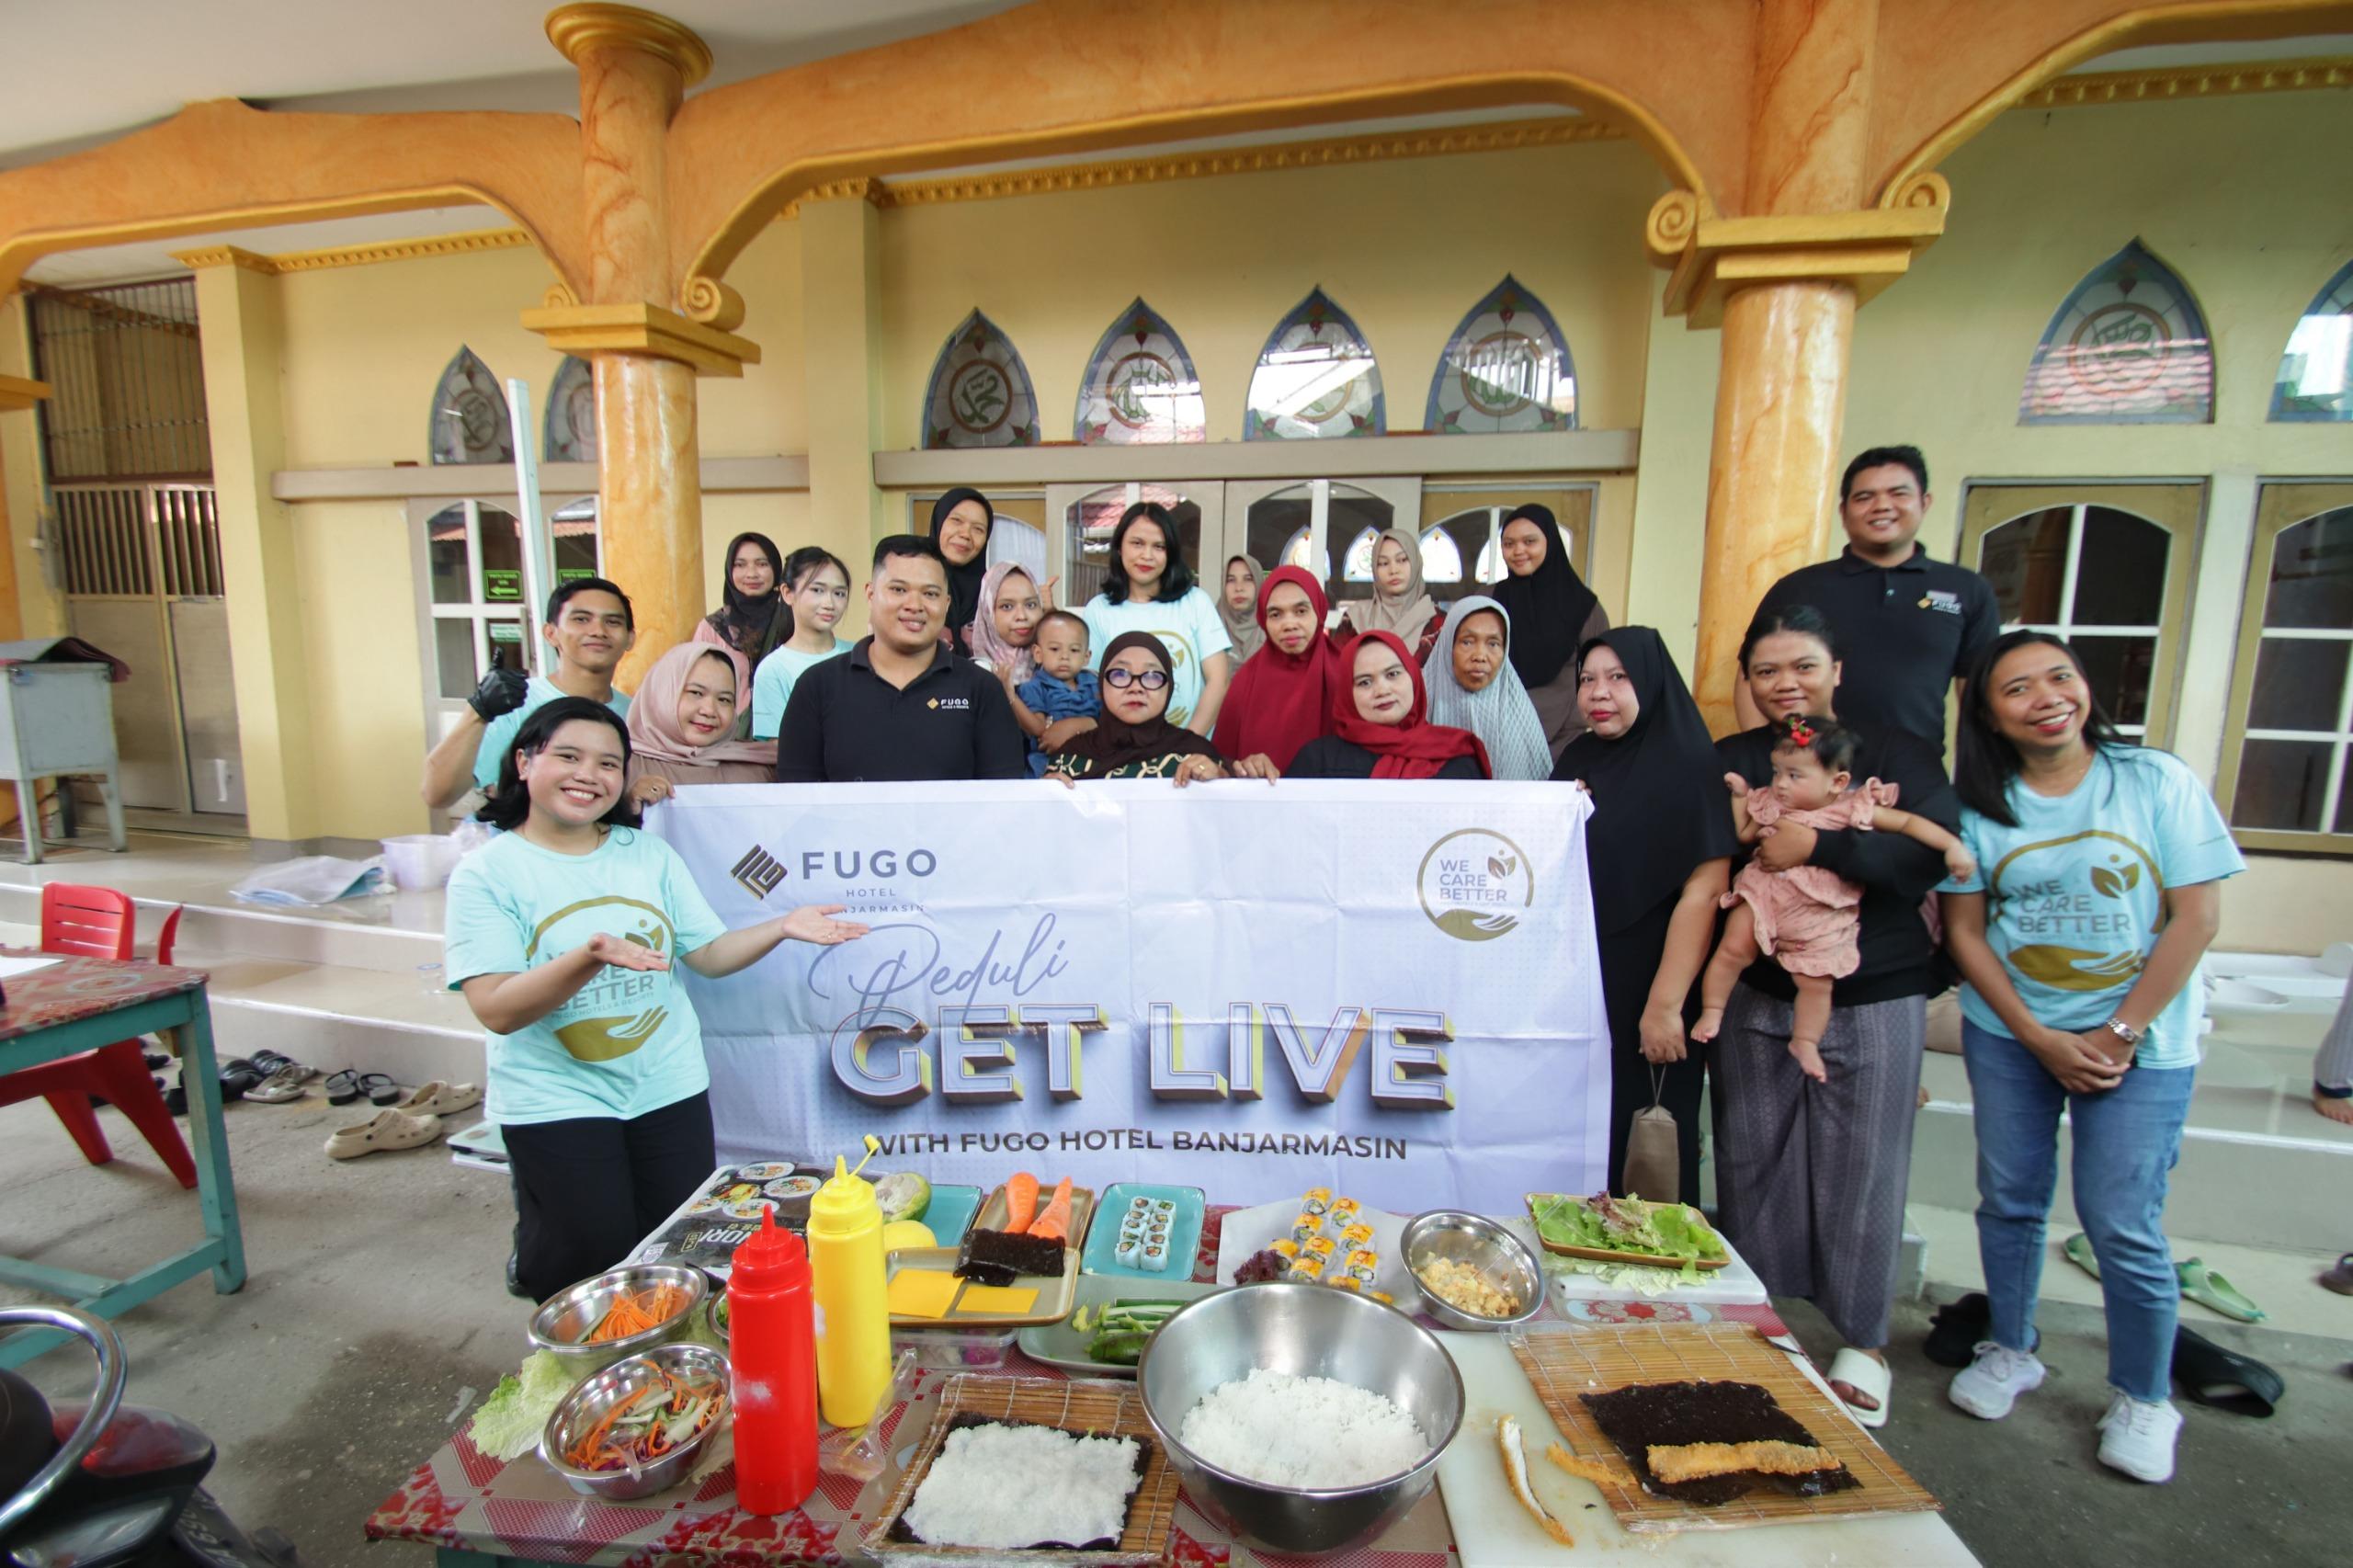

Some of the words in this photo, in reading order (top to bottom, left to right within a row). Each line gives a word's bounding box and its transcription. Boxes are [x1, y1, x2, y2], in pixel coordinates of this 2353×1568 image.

[802, 848, 937, 880] FUGO
[1440, 859, 1470, 872] WE
[1439, 873, 1487, 887] CARE
[847, 888, 896, 898] HOTEL
[1439, 888, 1507, 902] BETTER
[841, 903, 925, 914] NJARMASIN
[2020, 894, 2093, 913] CARE
[2018, 914, 2131, 933] BETTER
[808, 913, 1069, 1029] Peduli
[831, 1003, 1108, 1102] GET
[1149, 1002, 1455, 1110] LIVE
[864, 1133, 949, 1156] WITH
[961, 1131, 1050, 1153] FUGO
[1060, 1129, 1163, 1151] HOTEL
[1173, 1131, 1406, 1160] BANJARMASIN
